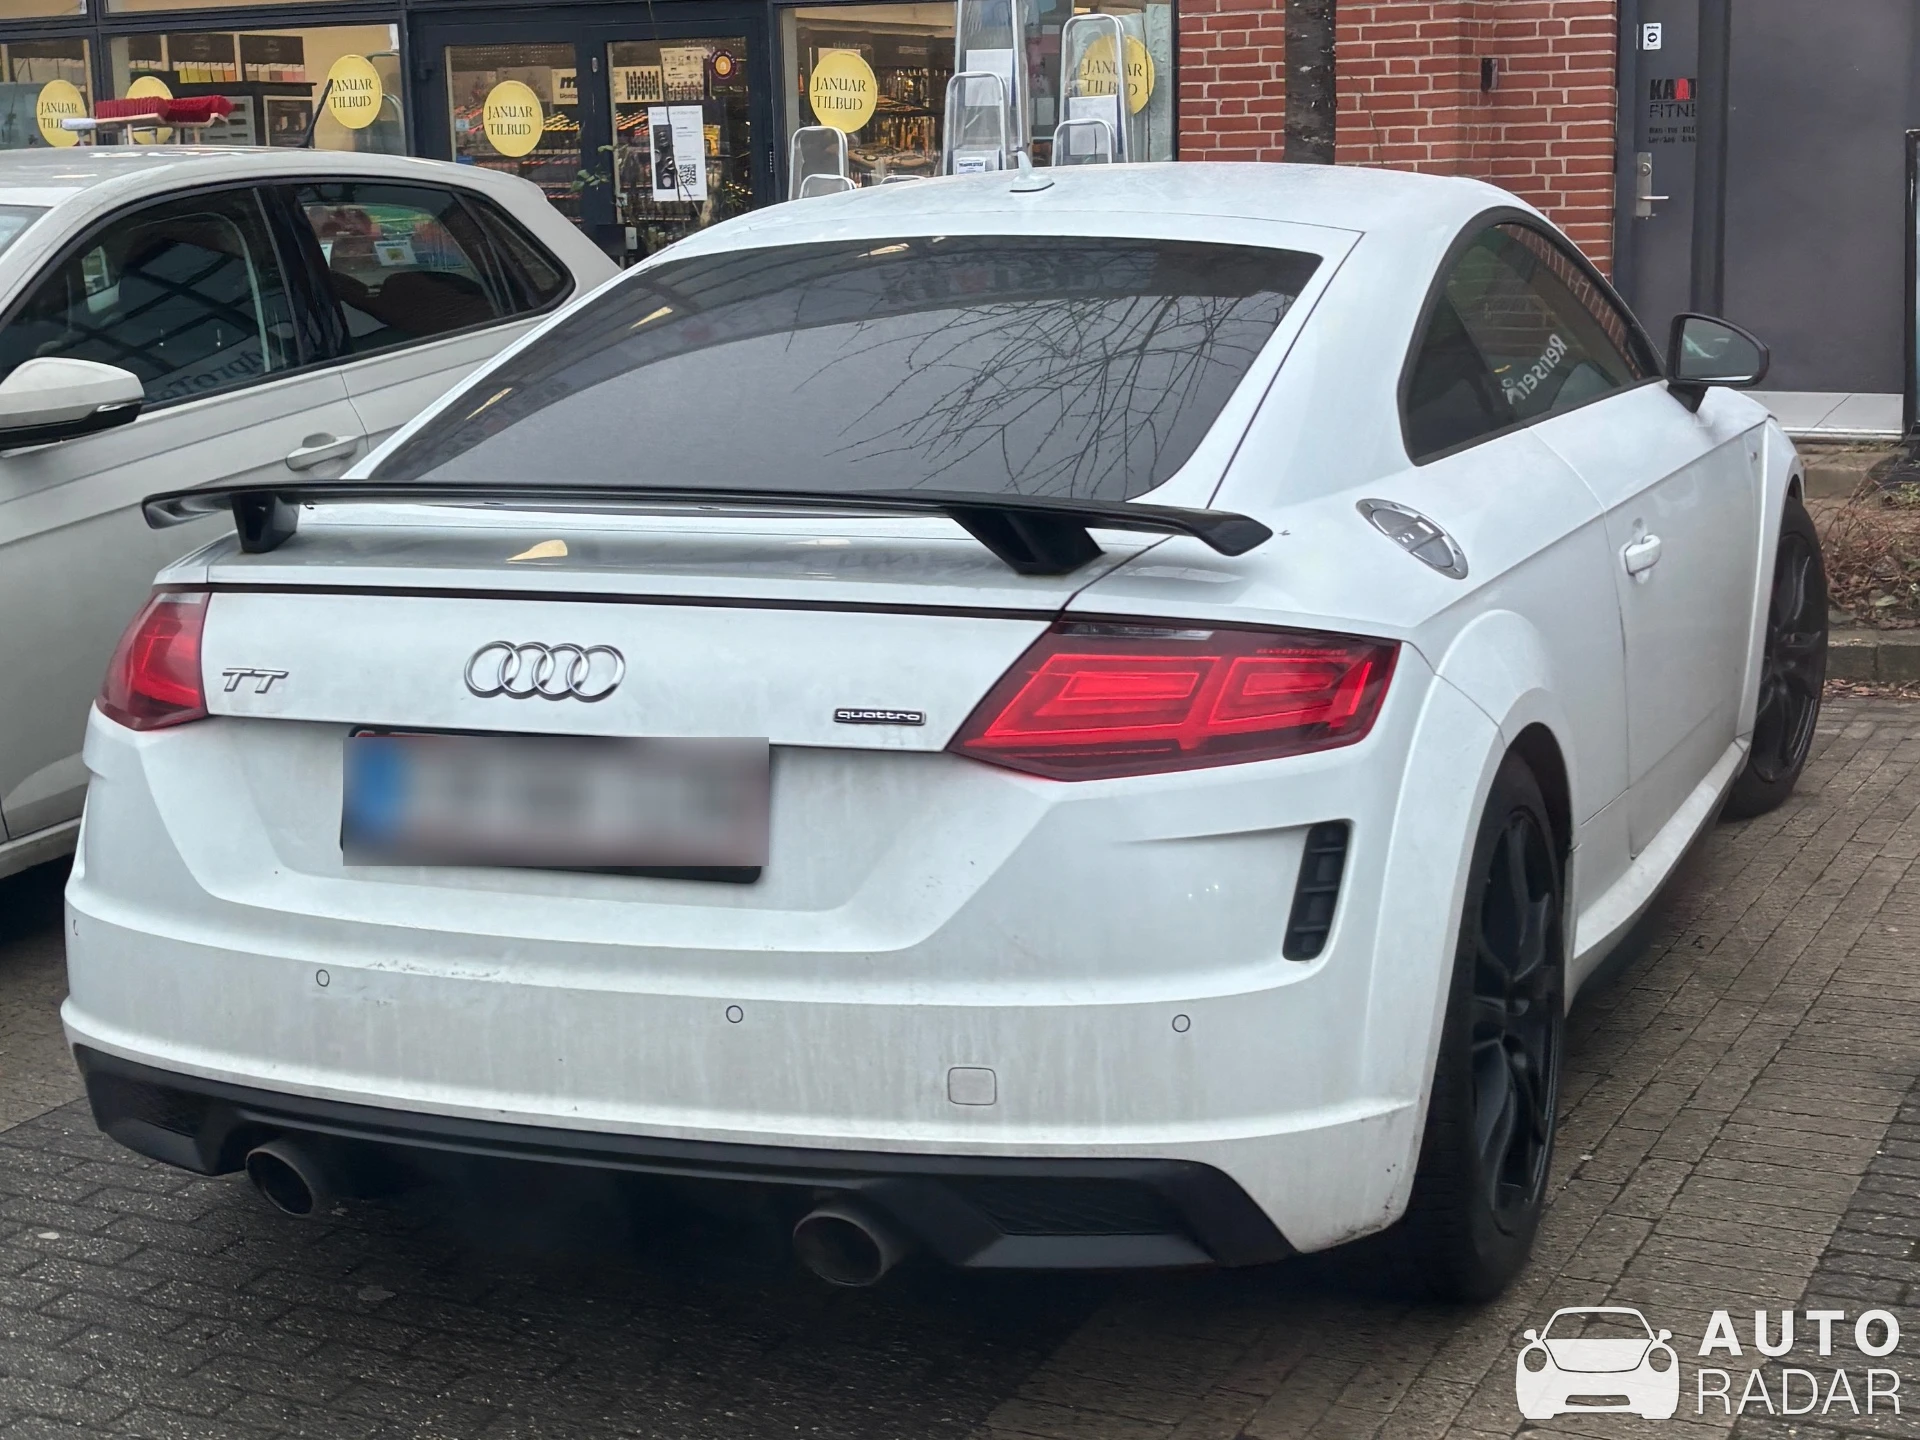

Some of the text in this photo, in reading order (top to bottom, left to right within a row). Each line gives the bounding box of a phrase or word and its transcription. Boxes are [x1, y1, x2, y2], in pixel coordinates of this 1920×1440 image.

[813, 77, 866, 92] JANUAR
[1084, 79, 1138, 96] TILBD
[40, 102, 77, 115] JANUAR
[330, 95, 371, 108] TILBUD
[814, 95, 863, 110] TILBUD
[488, 105, 533, 120] JANUAR
[488, 123, 532, 135] TILBUD
[222, 667, 289, 694] TT
[837, 710, 920, 720] quattro
